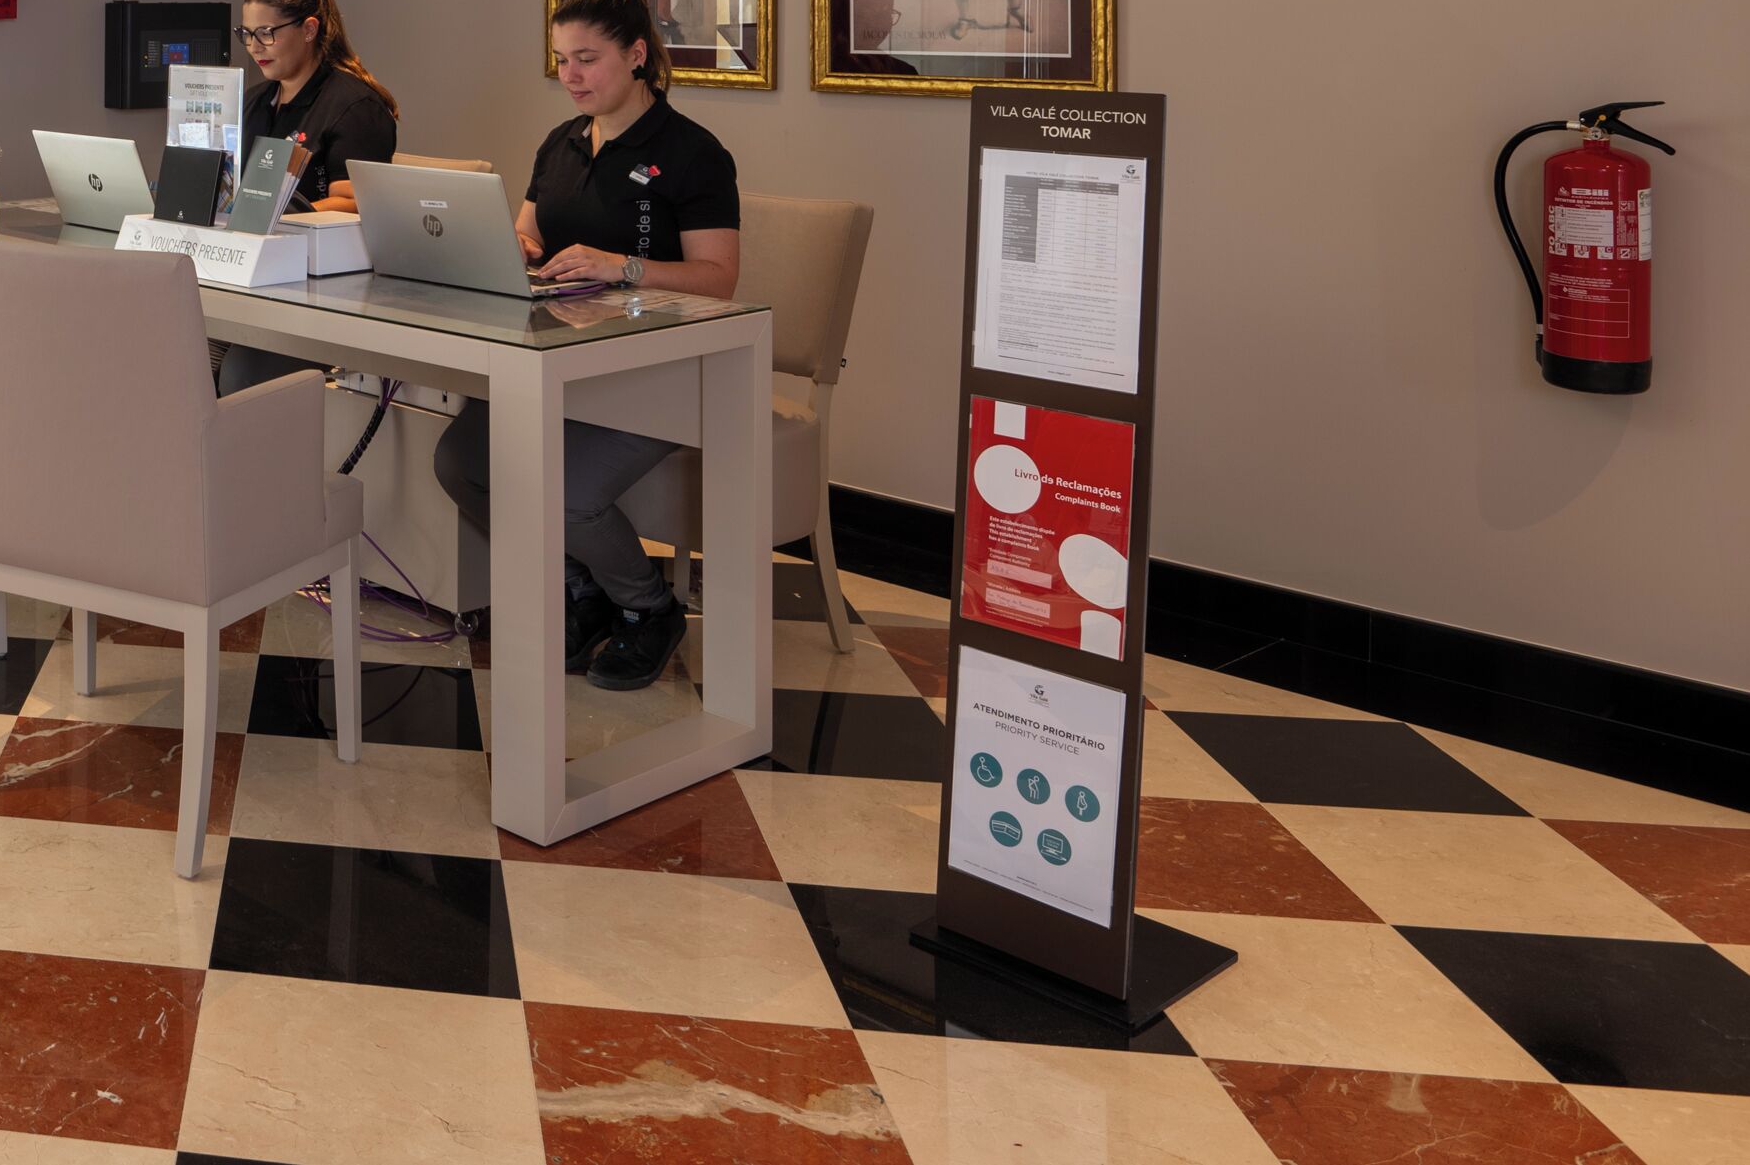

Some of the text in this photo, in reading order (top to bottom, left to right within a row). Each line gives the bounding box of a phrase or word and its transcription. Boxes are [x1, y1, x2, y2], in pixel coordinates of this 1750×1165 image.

[990, 106, 1147, 125] VILA GALÉ COLLECTION
[1041, 126, 1092, 140] TOMAR
[636, 200, 651, 211] si
[423, 215, 443, 237] hp
[636, 216, 651, 233] de
[150, 235, 247, 266] VOUCHERS PRESENTE
[1014, 468, 1122, 499] Livro de Reclamações
[1054, 492, 1121, 514] Complaints Book
[973, 702, 1105, 751] ATENDIMENTO PRIORITÁRIO
[995, 721, 1080, 755] PRIORITY SERVICE
